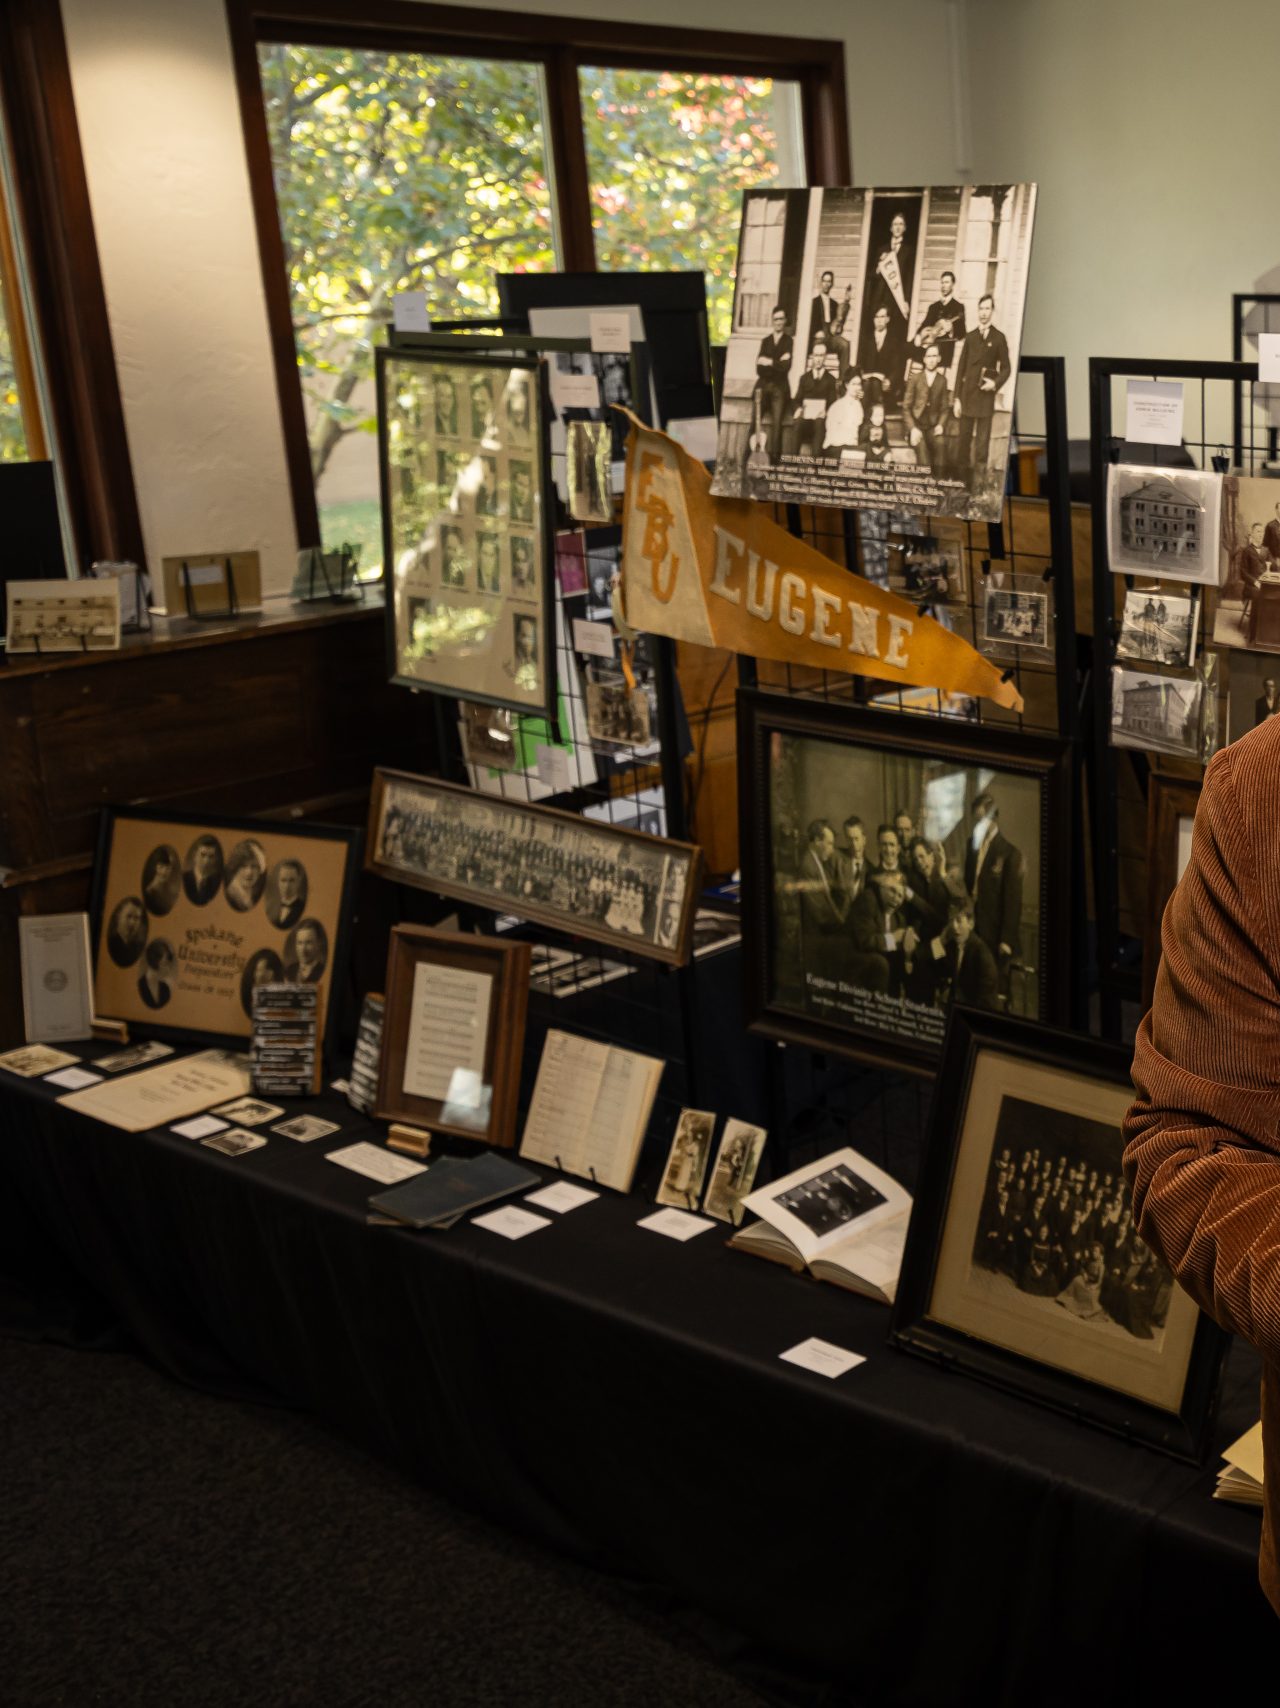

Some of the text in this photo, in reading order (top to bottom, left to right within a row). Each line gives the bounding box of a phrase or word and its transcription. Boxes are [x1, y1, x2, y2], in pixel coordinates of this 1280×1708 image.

[710, 523, 914, 669] EUGENE
[178, 944, 246, 970] University
[805, 972, 836, 990] Eugene
[838, 980, 872, 1002] Divinity
[873, 990, 903, 1008] School
